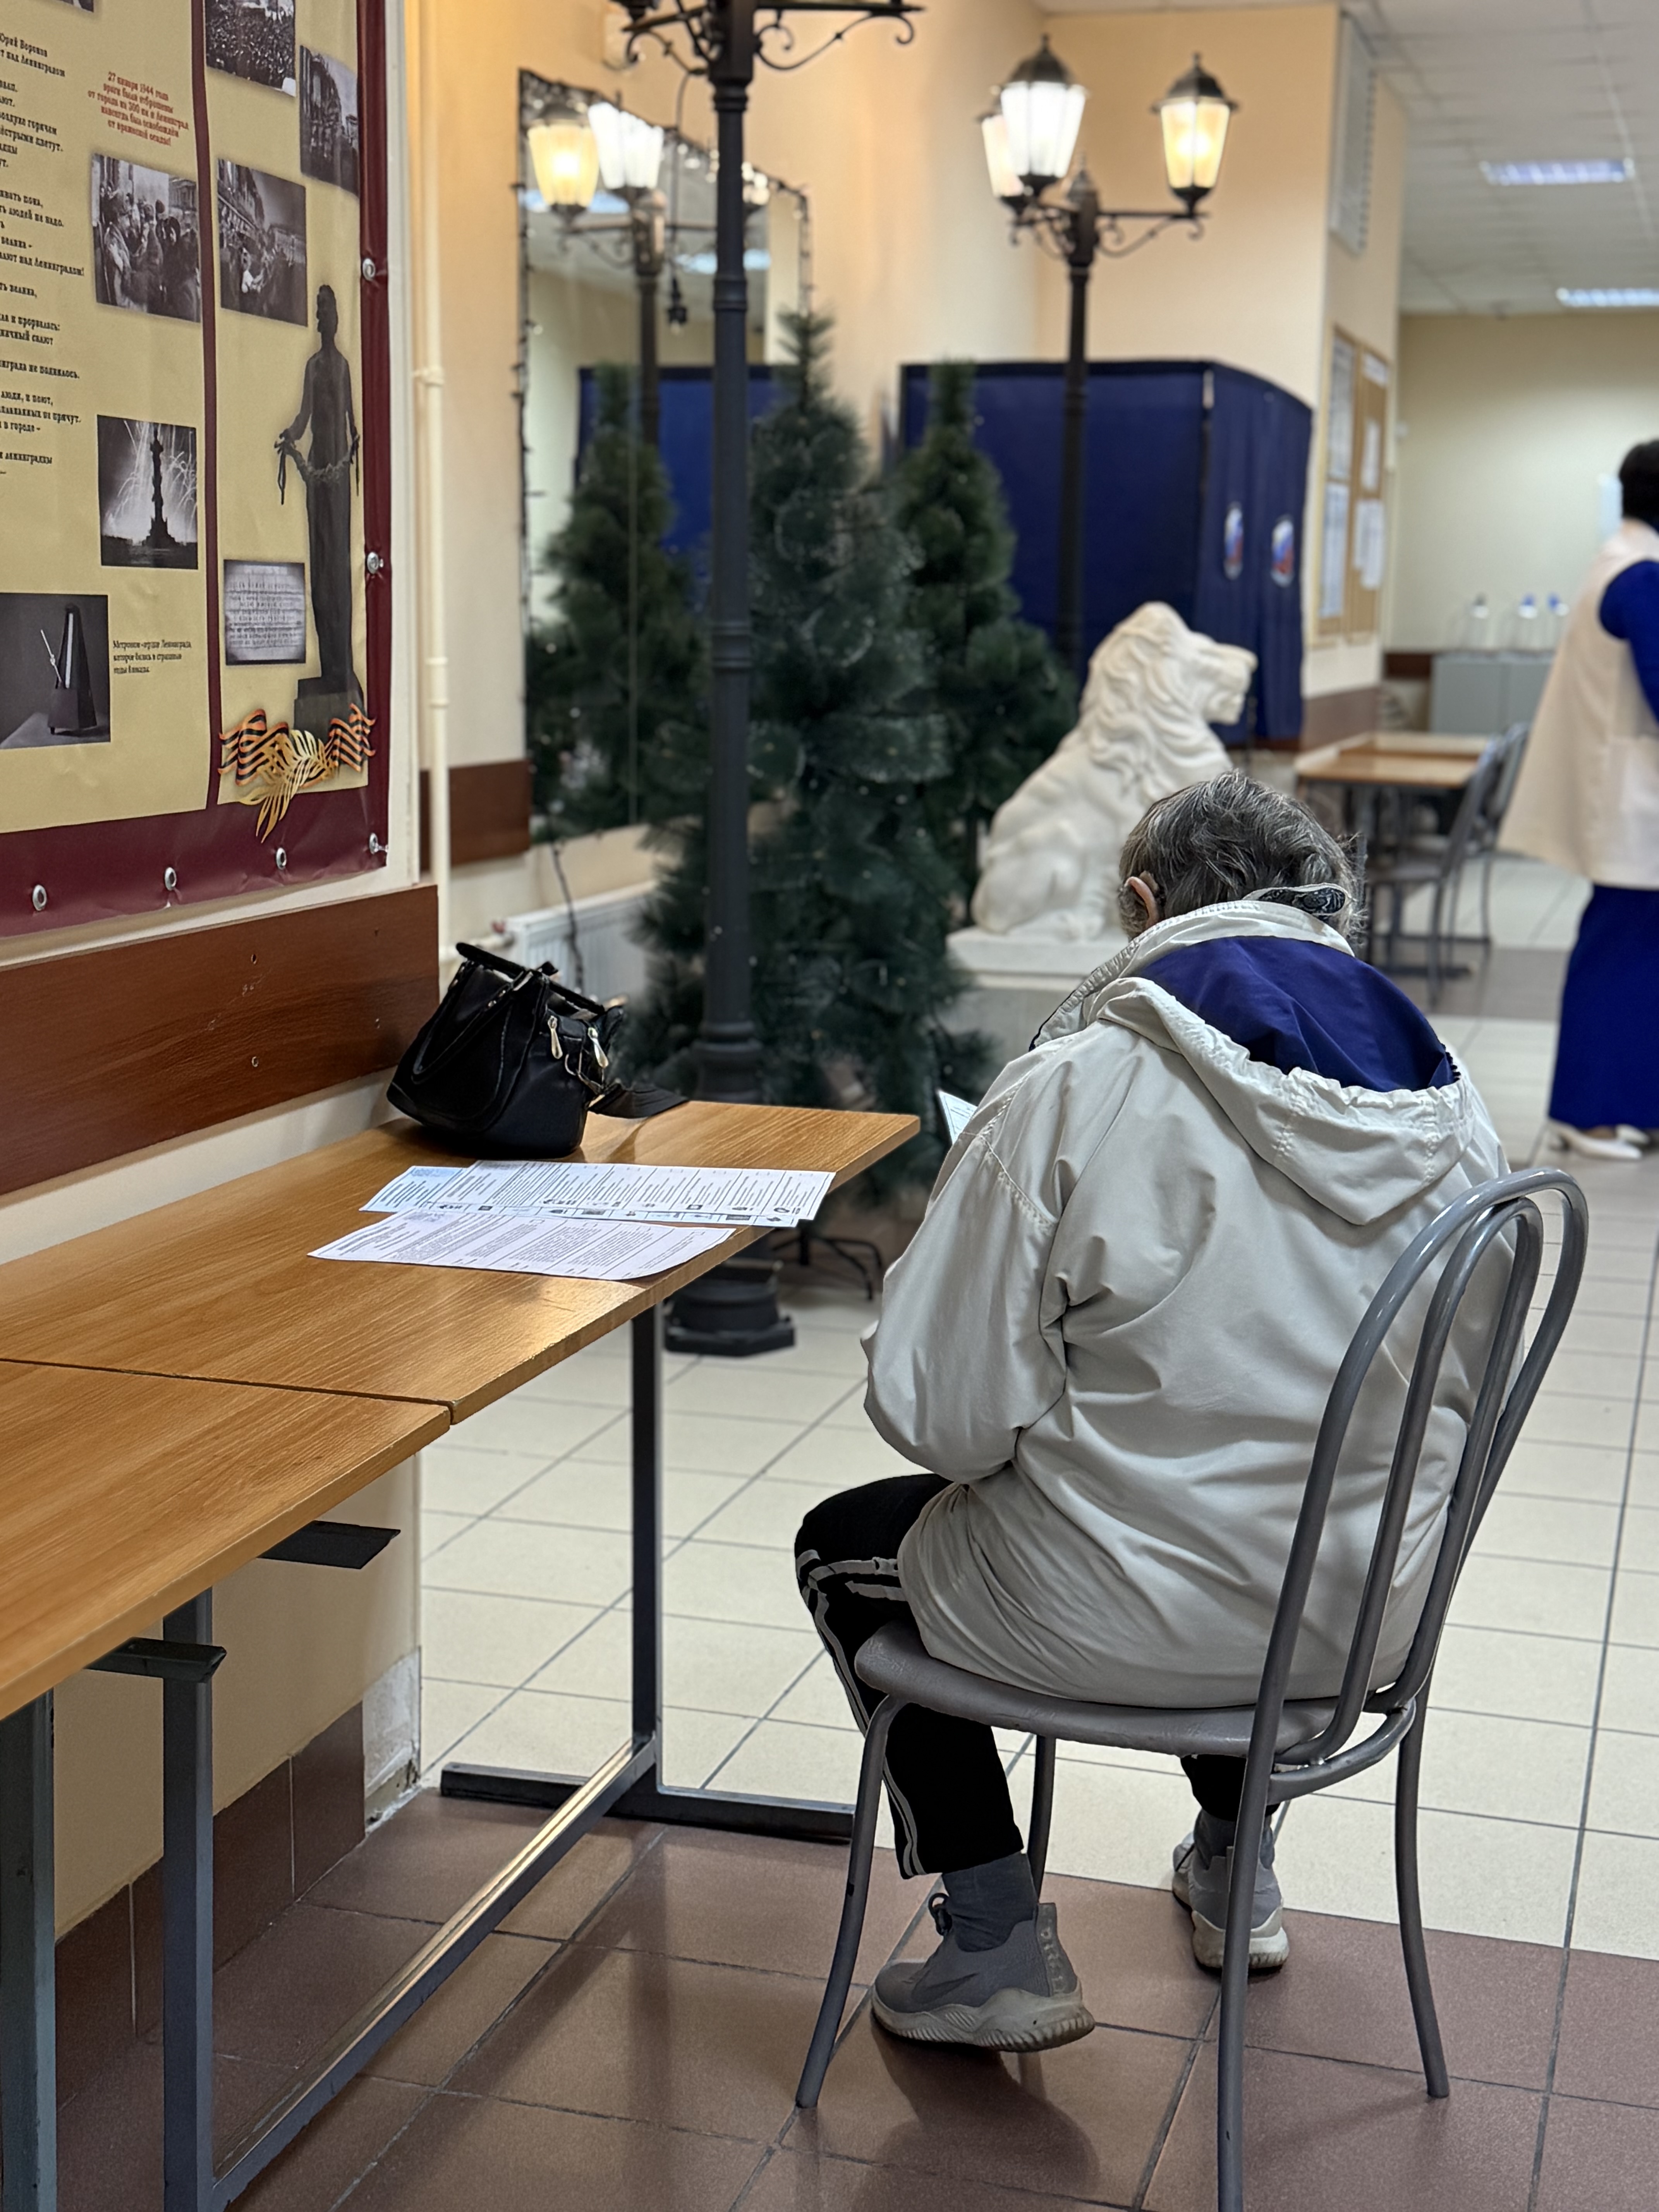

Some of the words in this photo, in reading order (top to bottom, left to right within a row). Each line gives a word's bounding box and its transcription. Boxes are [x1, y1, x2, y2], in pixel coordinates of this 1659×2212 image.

[21, 54, 65, 77] Ленинградом
[27, 119, 57, 135] горячем
[36, 137, 63, 152] цветут.
[9, 208, 33, 220] людей
[32, 334, 53, 345] салют
